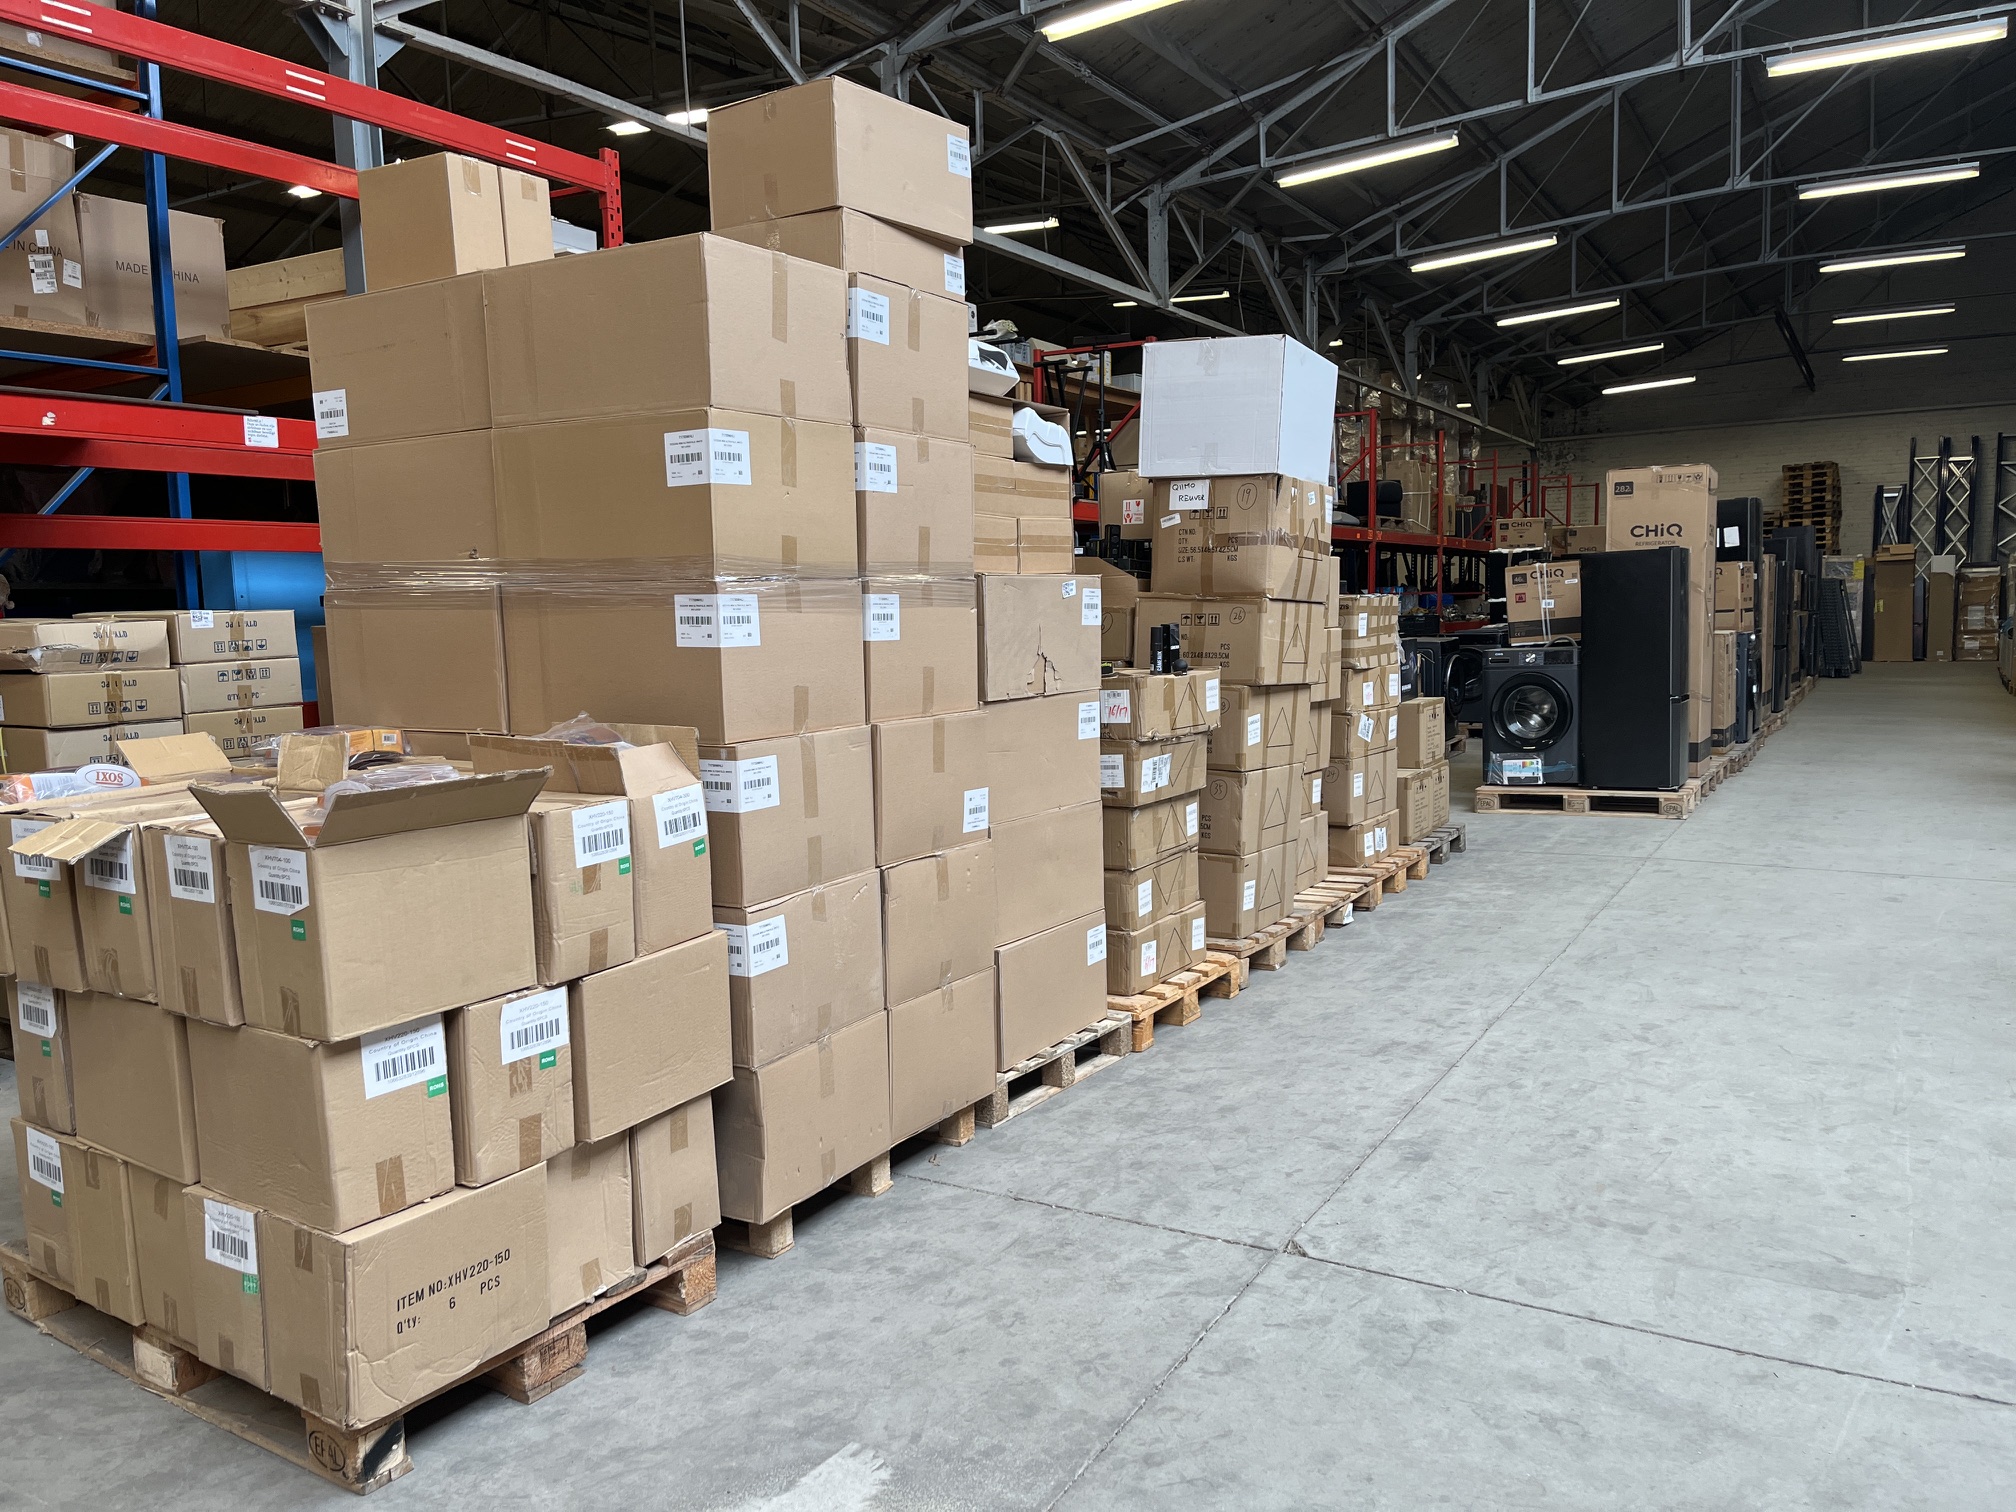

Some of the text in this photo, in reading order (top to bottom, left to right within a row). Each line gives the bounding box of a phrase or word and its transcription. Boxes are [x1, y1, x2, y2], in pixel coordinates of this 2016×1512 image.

[13, 240, 25, 251] IN
[115, 260, 200, 283] MADE HINA
[1241, 488, 1252, 505] 19
[1630, 523, 1683, 538] CHiQ
[1227, 536, 1239, 544] PCS
[1233, 611, 1243, 621] 26
[225, 621, 234, 629] PC
[1220, 643, 1231, 651] PCS
[101, 680, 110, 688] PC
[102, 734, 112, 742] PC
[95, 771, 124, 783] IXOS
[1213, 783, 1223, 796] 35
[1664, 804, 1680, 812] EPAL
[1201, 814, 1212, 822] PCS
[384, 1026, 419, 1043] XHV220-150
[368, 1043, 391, 1055] Country
[396, 1289, 425, 1312] ITEM
[396, 1275, 501, 1335] Q'ty: 6 PCS
